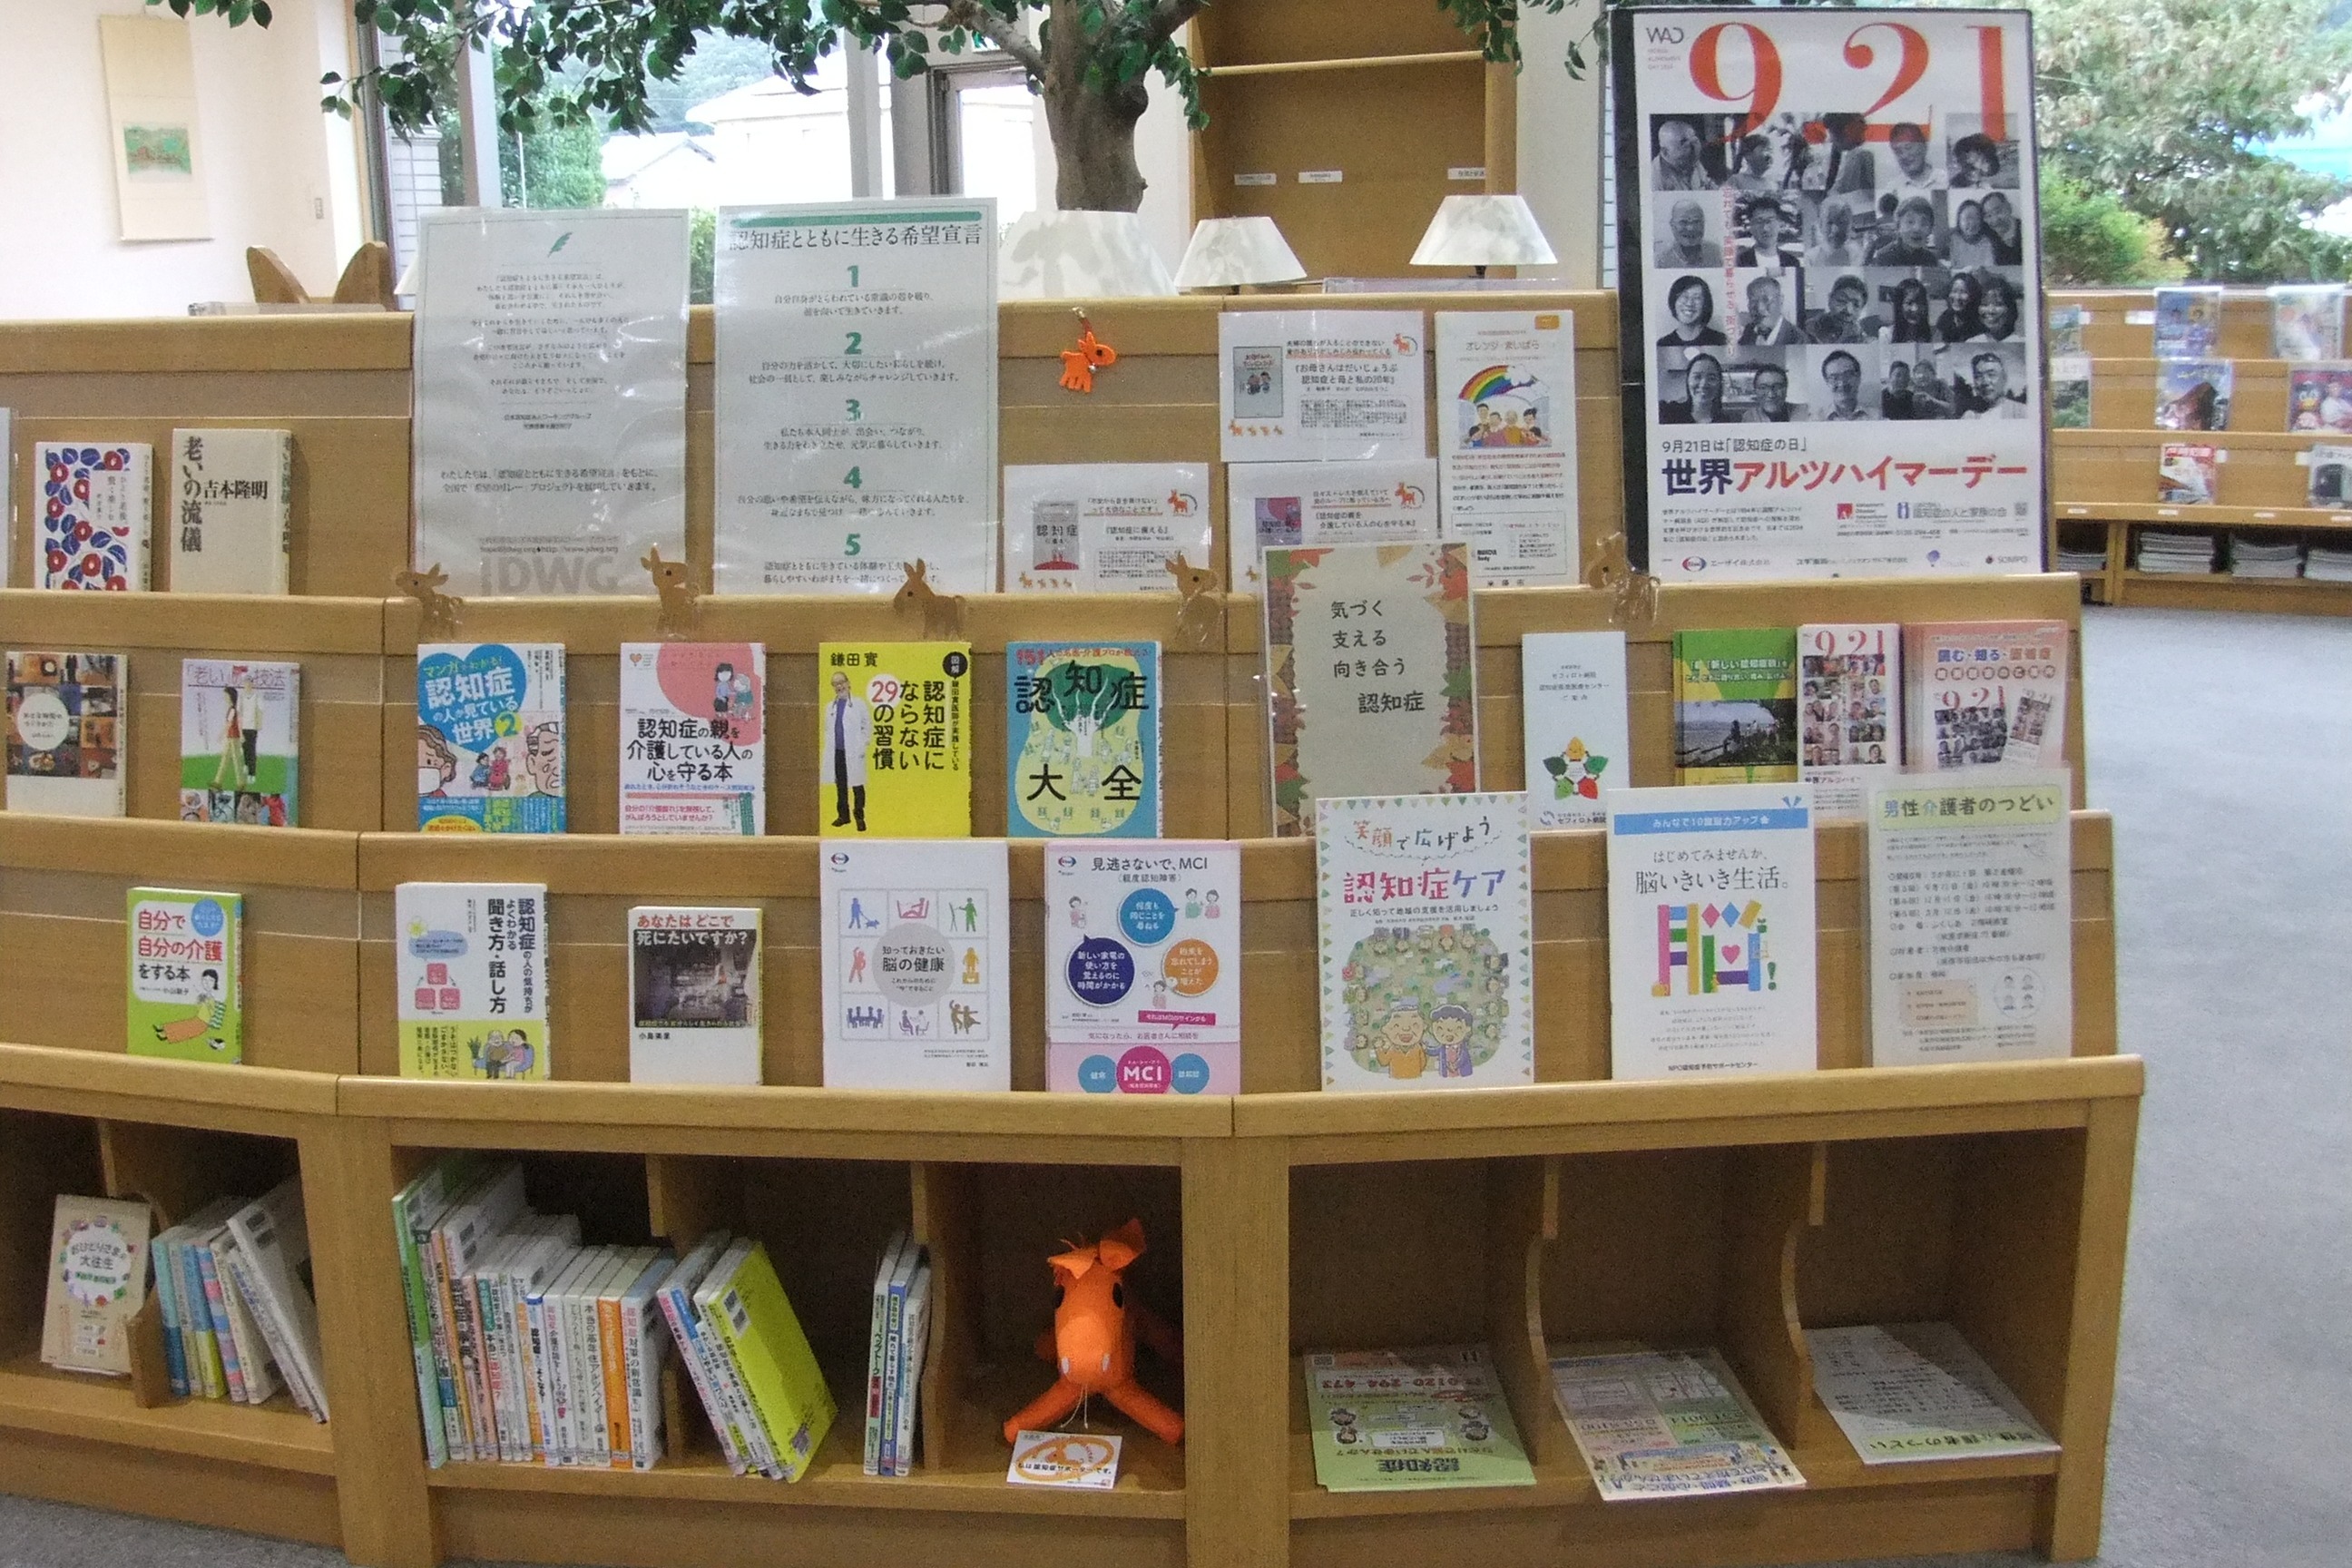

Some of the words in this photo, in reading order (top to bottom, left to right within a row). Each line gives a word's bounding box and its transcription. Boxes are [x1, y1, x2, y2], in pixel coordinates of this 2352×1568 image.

[1689, 21, 2010, 146] 9.21
[728, 223, 983, 251] 認知症とともに生きる希望宣言
[846, 264, 860, 289] 1
[844, 331, 863, 355] 2
[845, 398, 861, 422] 3
[1661, 437, 1808, 455] 9月21日は「認知症の日」
[843, 466, 863, 489] 4
[1661, 454, 2029, 496] 世界アルツハイマーデー
[181, 435, 204, 553] 老いの流儀
[203, 478, 269, 500] 吉本隆明
[844, 533, 862, 556] 5
[1330, 600, 1384, 620] 気づく
[1332, 629, 1388, 650] 支える
[829, 652, 861, 668] 鎌田
[1333, 657, 1406, 680] 向き合う
[425, 665, 516, 710] 認知症
[1014, 659, 1150, 714] 認知症
[432, 696, 519, 723] の人が見ている
[1357, 689, 1426, 714] 認知症
[451, 717, 495, 746] 世界
[499, 713, 519, 737] 2
[637, 718, 741, 740] 認知症の親を
[871, 680, 899, 770] 29の習慣
[899, 680, 920, 770] ならない
[923, 680, 946, 770] 認知症に
[626, 740, 754, 761] 介護している人の
[646, 760, 733, 783] 心を守る本
[1025, 762, 1142, 802] 大全
[1884, 793, 2055, 818] 男性介護者のつどい
[1352, 815, 1491, 851] 笑顔で広げよう
[1653, 848, 1769, 864] はじめてみませんか、
[1342, 867, 1506, 904] 認知症ケア
[1635, 865, 1790, 896] 脳いきいき生活。
[138, 908, 186, 932] 自分で
[637, 914, 692, 928] あなたは
[695, 914, 735, 928] どこで
[1129, 910, 1165, 921] 同じことを
[1349, 904, 1499, 918] 正しく知って地域の支援を活用しましょう
[505, 898, 517, 951] よくわかる
[138, 935, 223, 963] 自分の介護
[636, 930, 748, 946] 死にたいですか?
[487, 897, 507, 1014] 聞き方・話し方
[517, 897, 536, 1014] 認知症の人の気持ちが
[882, 946, 946, 956] 知っておきたい
[1076, 951, 1126, 961] 新しい家電の
[1170, 956, 1212, 966] 忘れてしまう
[138, 963, 191, 983] をする本
[882, 956, 945, 973] 脳の健康
[1082, 971, 1122, 981] 覚えるのに
[1084, 961, 1118, 971] 使い方を
[1181, 967, 1202, 976] ことが
[1076, 981, 1126, 991] 時間がかかる
[1122, 1065, 1162, 1082] MCI
[1377, 1457, 1461, 1474] 認知症
